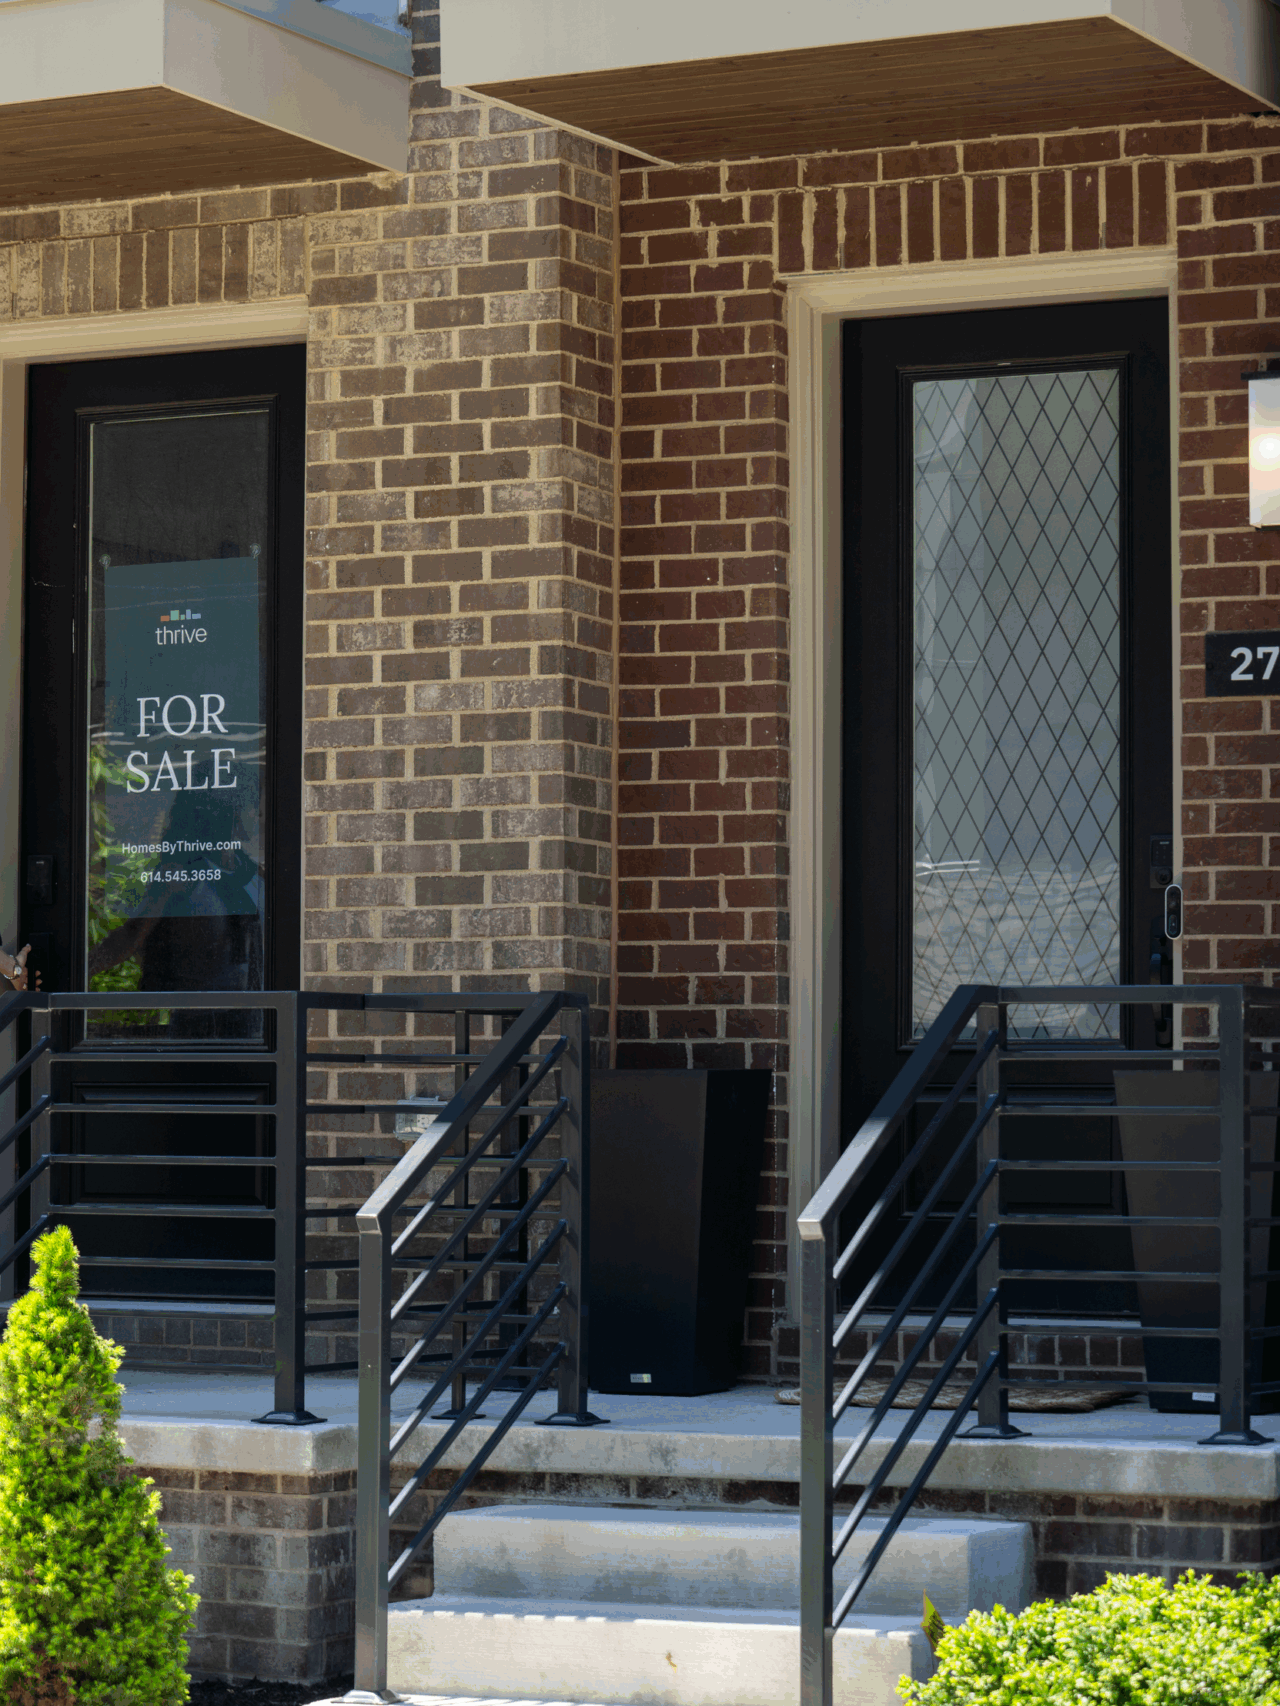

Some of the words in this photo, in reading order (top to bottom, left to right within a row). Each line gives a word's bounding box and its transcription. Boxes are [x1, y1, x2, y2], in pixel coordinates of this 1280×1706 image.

[155, 625, 208, 645] thrive
[136, 694, 229, 738] FOR
[126, 748, 238, 794] SALE
[121, 840, 242, 855] HomesByThrive.com
[140, 869, 222, 883] 614.545.3658
